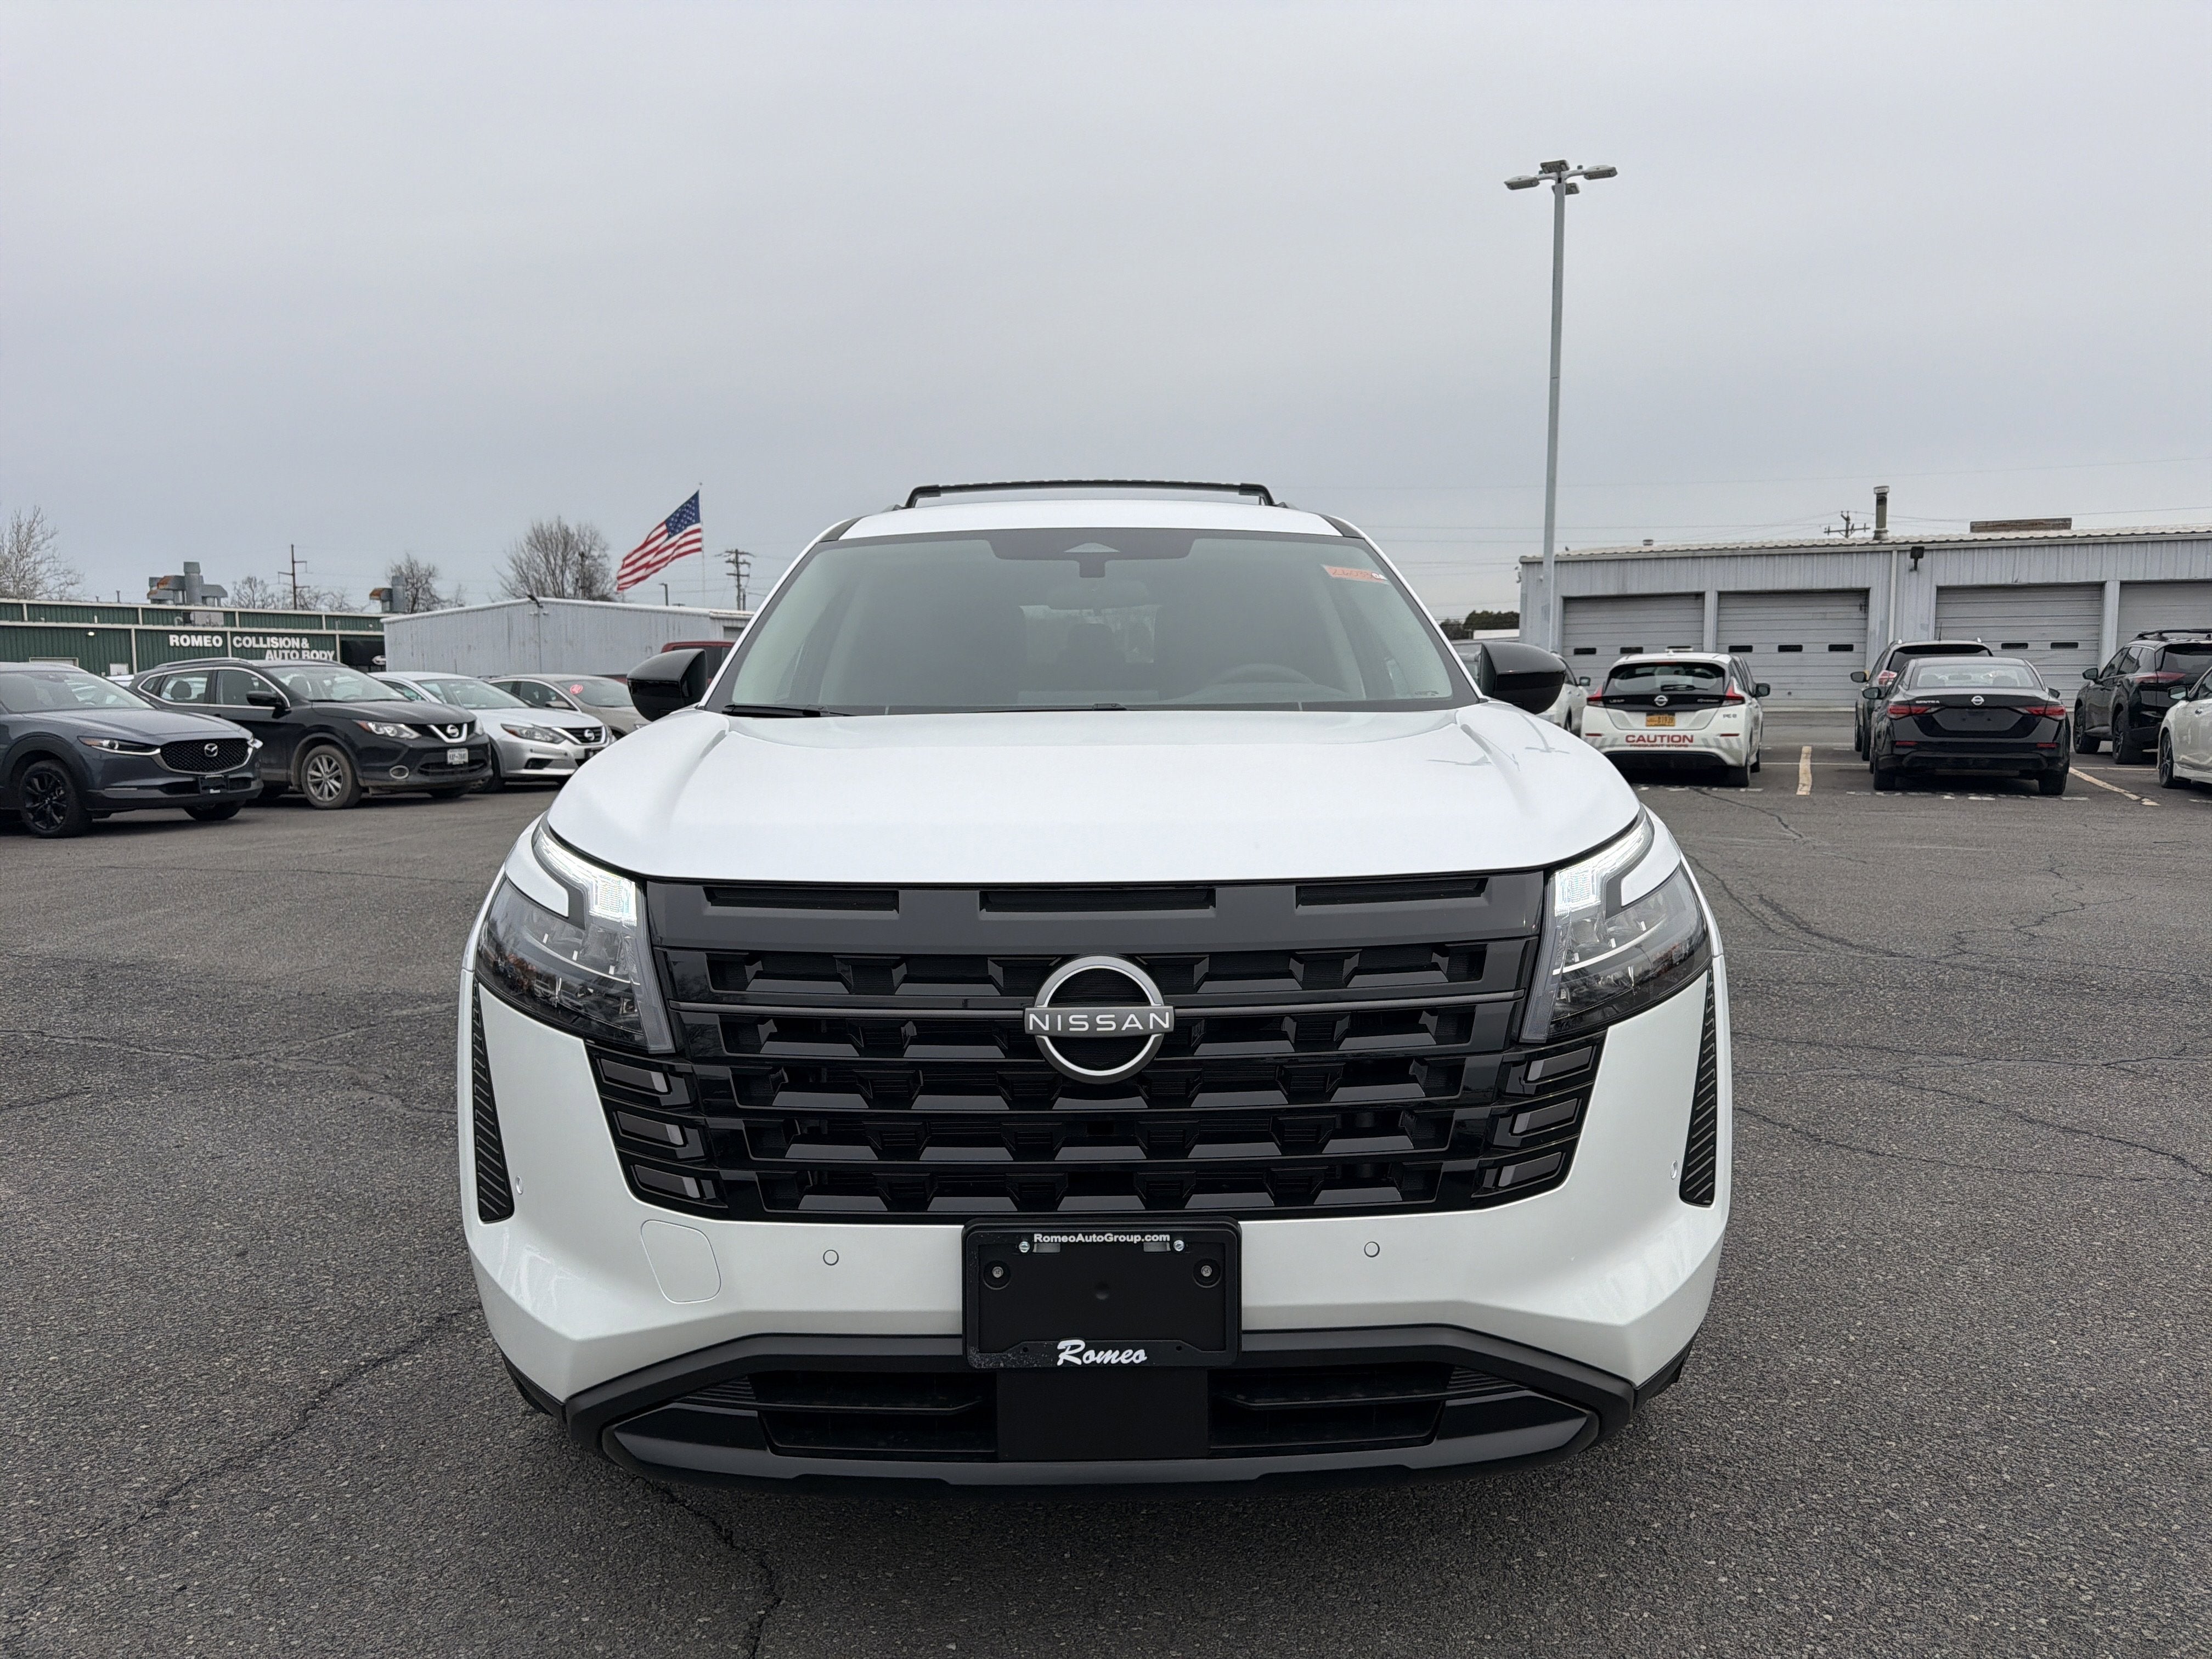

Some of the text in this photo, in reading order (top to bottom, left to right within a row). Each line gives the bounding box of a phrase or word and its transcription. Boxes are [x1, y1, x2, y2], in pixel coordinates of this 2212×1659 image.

[169, 635, 223, 647] ROMEO
[266, 650, 335, 661] AUTO BODY
[1626, 735, 1694, 743] CAUTION
[1029, 1012, 1170, 1031] NISSAN
[1034, 1233, 1170, 1243] RomeoAutoGroup.com
[1057, 1339, 1147, 1366] Romeo
